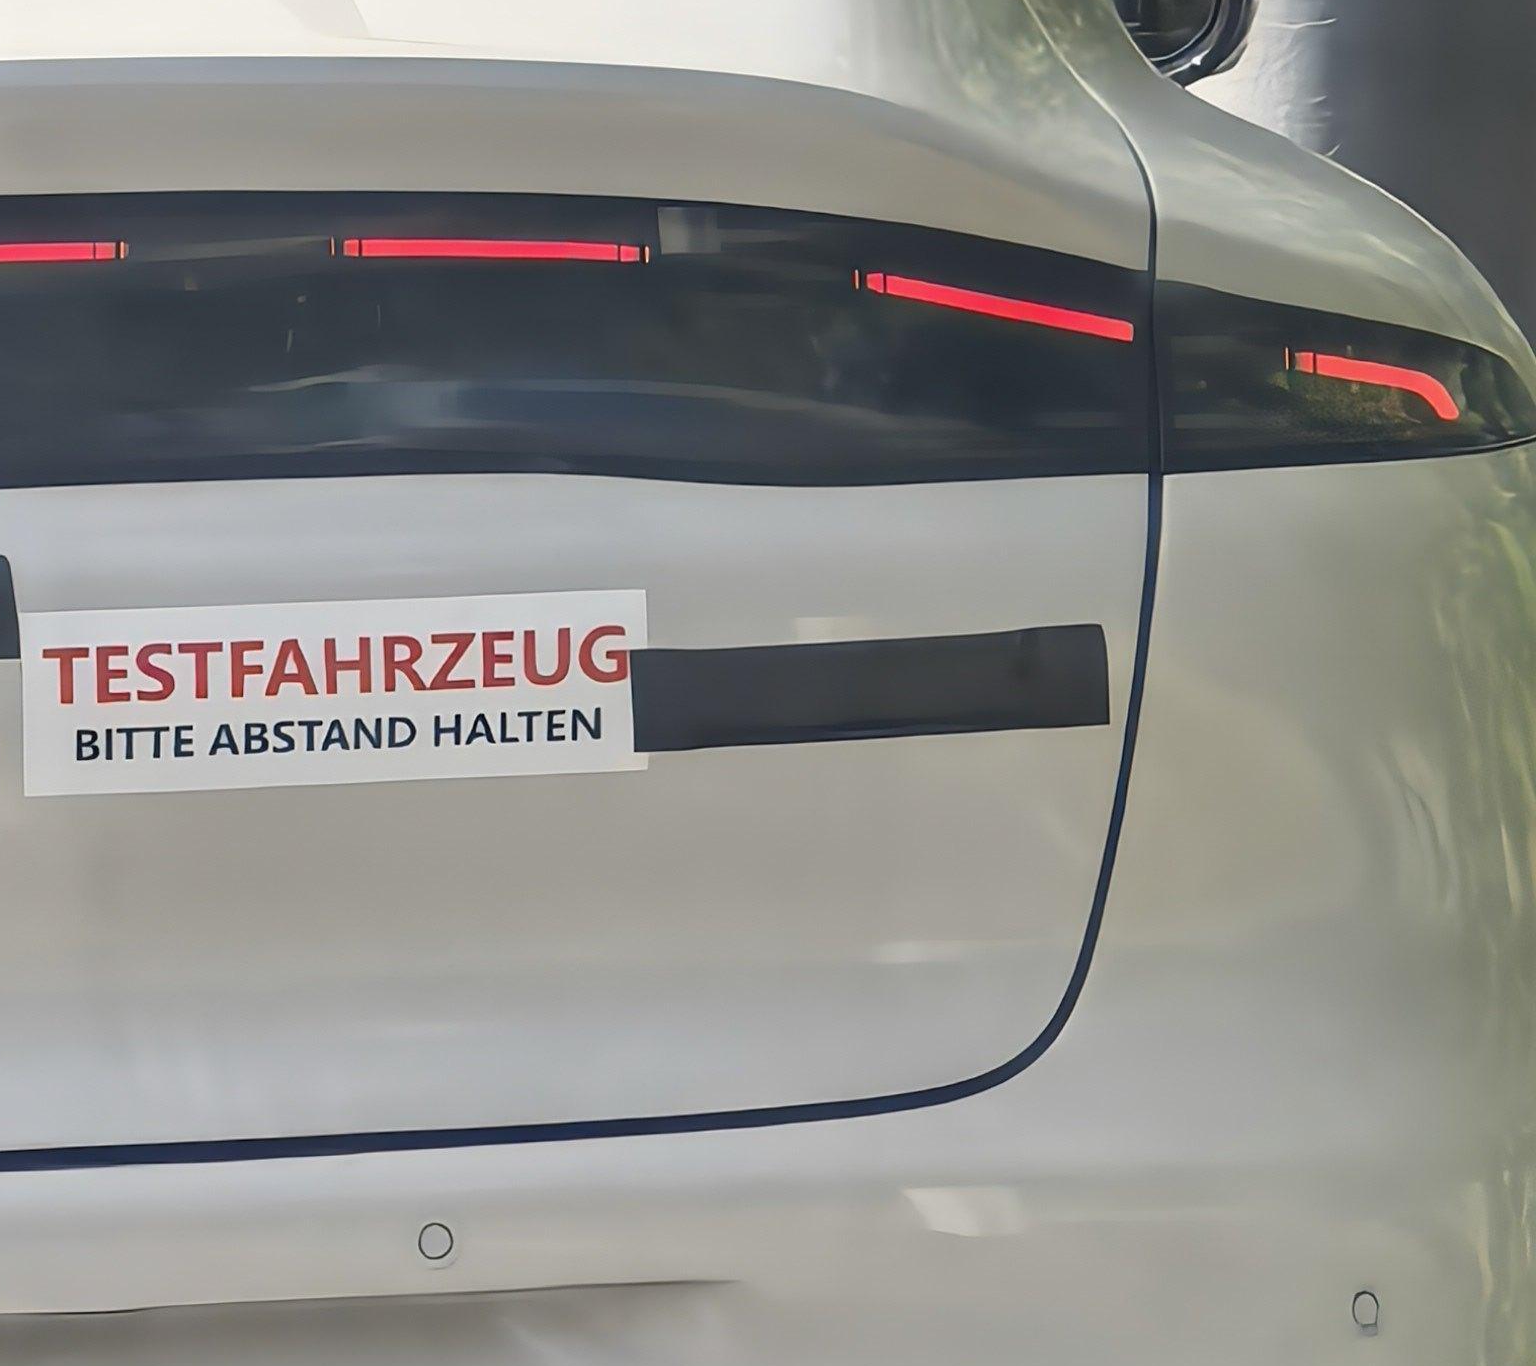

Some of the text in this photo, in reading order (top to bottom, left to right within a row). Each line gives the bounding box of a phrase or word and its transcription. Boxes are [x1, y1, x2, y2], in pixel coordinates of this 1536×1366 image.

[42, 625, 628, 705] TESTFAHRZEUG
[76, 707, 602, 762] BITTE ABSTAND HALTEN
